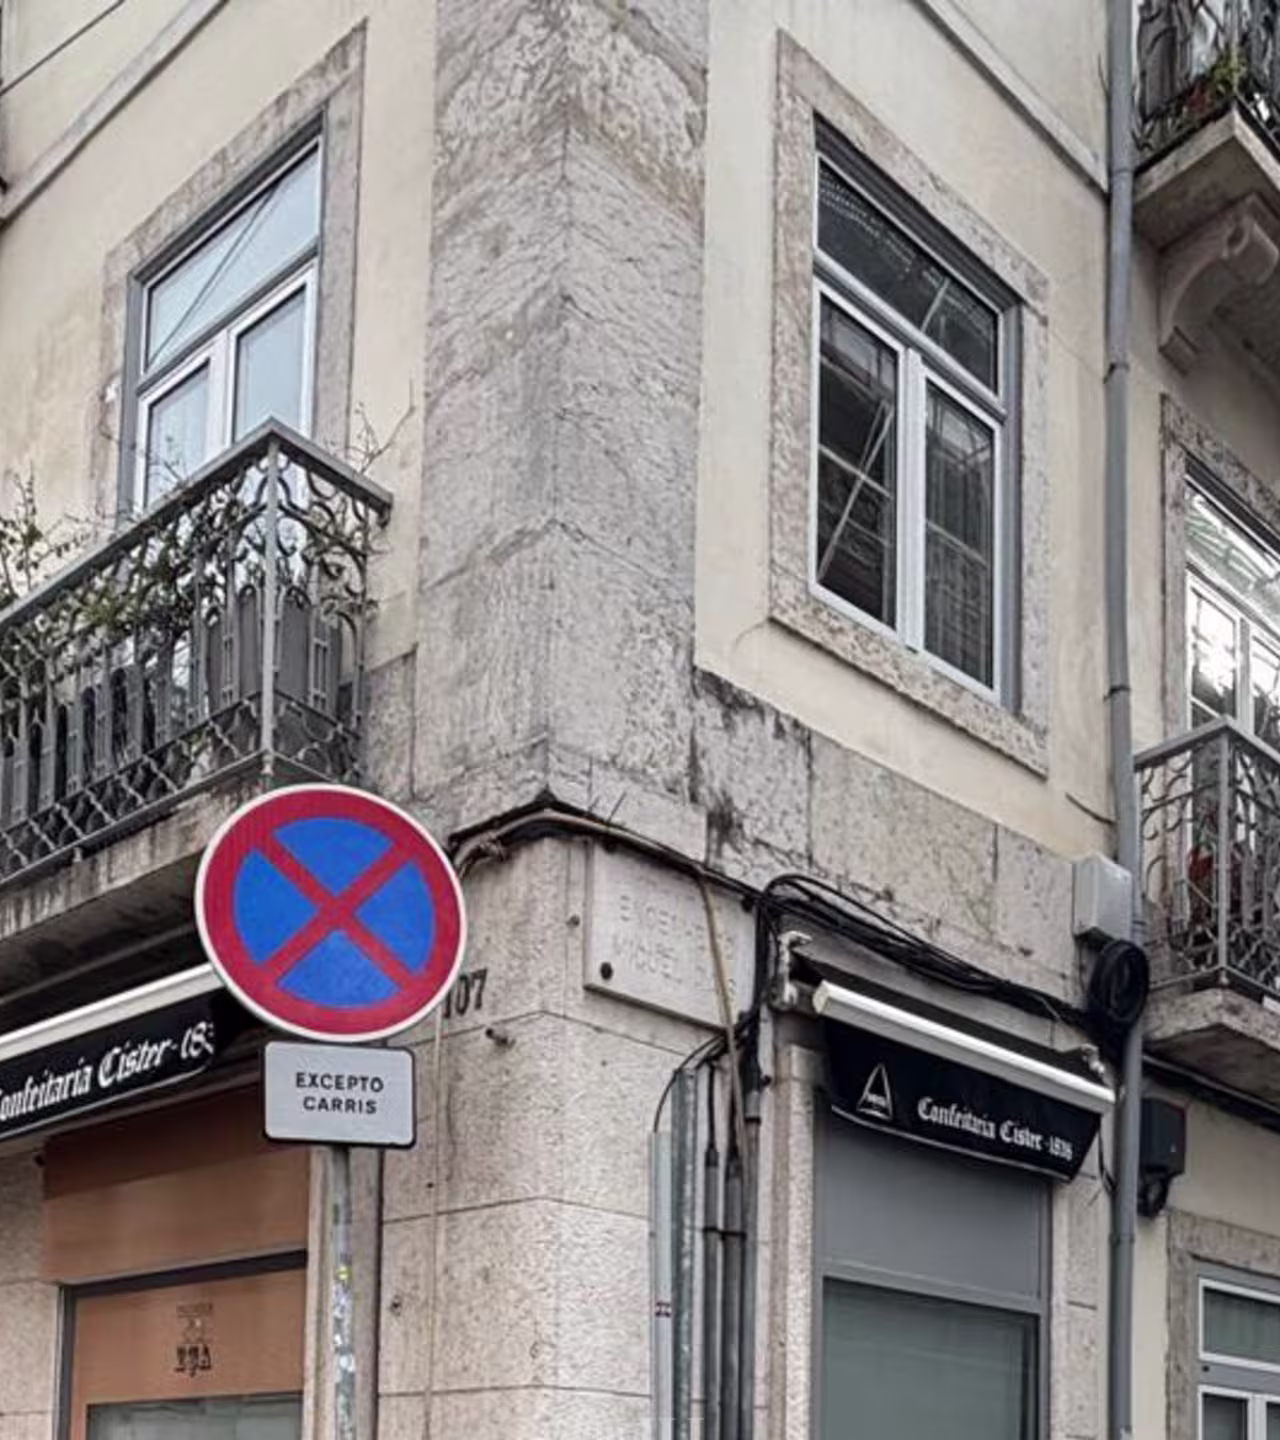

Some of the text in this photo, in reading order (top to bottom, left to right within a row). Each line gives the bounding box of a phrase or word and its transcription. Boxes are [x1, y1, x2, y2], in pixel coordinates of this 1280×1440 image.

[97, 1038, 171, 1088] Cister
[295, 1072, 384, 1093] EXCEPTO
[303, 1096, 377, 1115] CARRIS
[917, 1096, 996, 1139] Confeitaria
